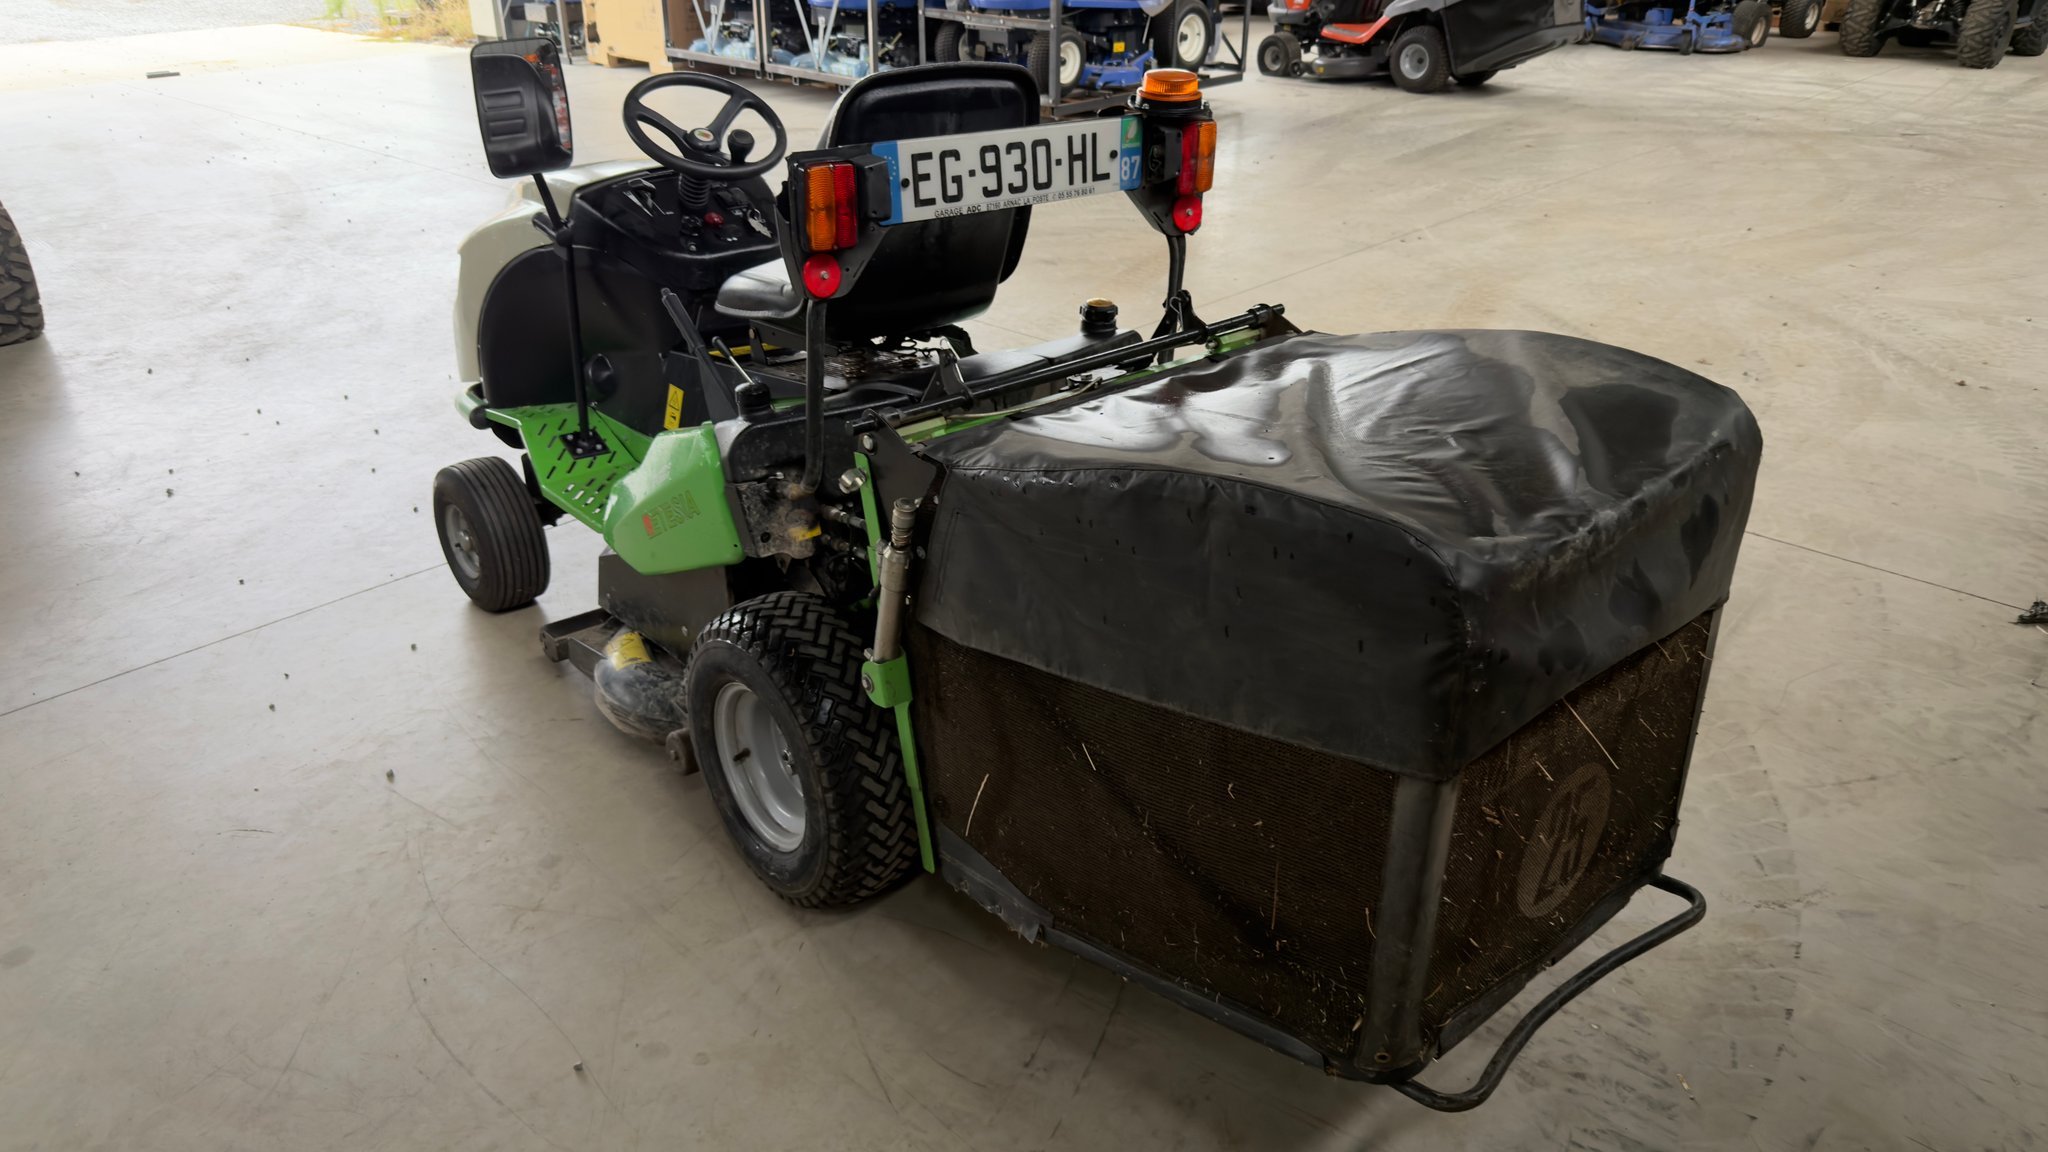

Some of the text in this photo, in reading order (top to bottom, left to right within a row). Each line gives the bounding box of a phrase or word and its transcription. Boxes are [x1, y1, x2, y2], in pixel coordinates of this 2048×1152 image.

[1121, 155, 1140, 180] 87
[935, 207, 963, 218] GARAGE
[967, 204, 982, 214] ADC
[1024, 197, 1030, 205] LA
[1032, 194, 1049, 203] POSTE
[642, 489, 701, 540] ETESIA
